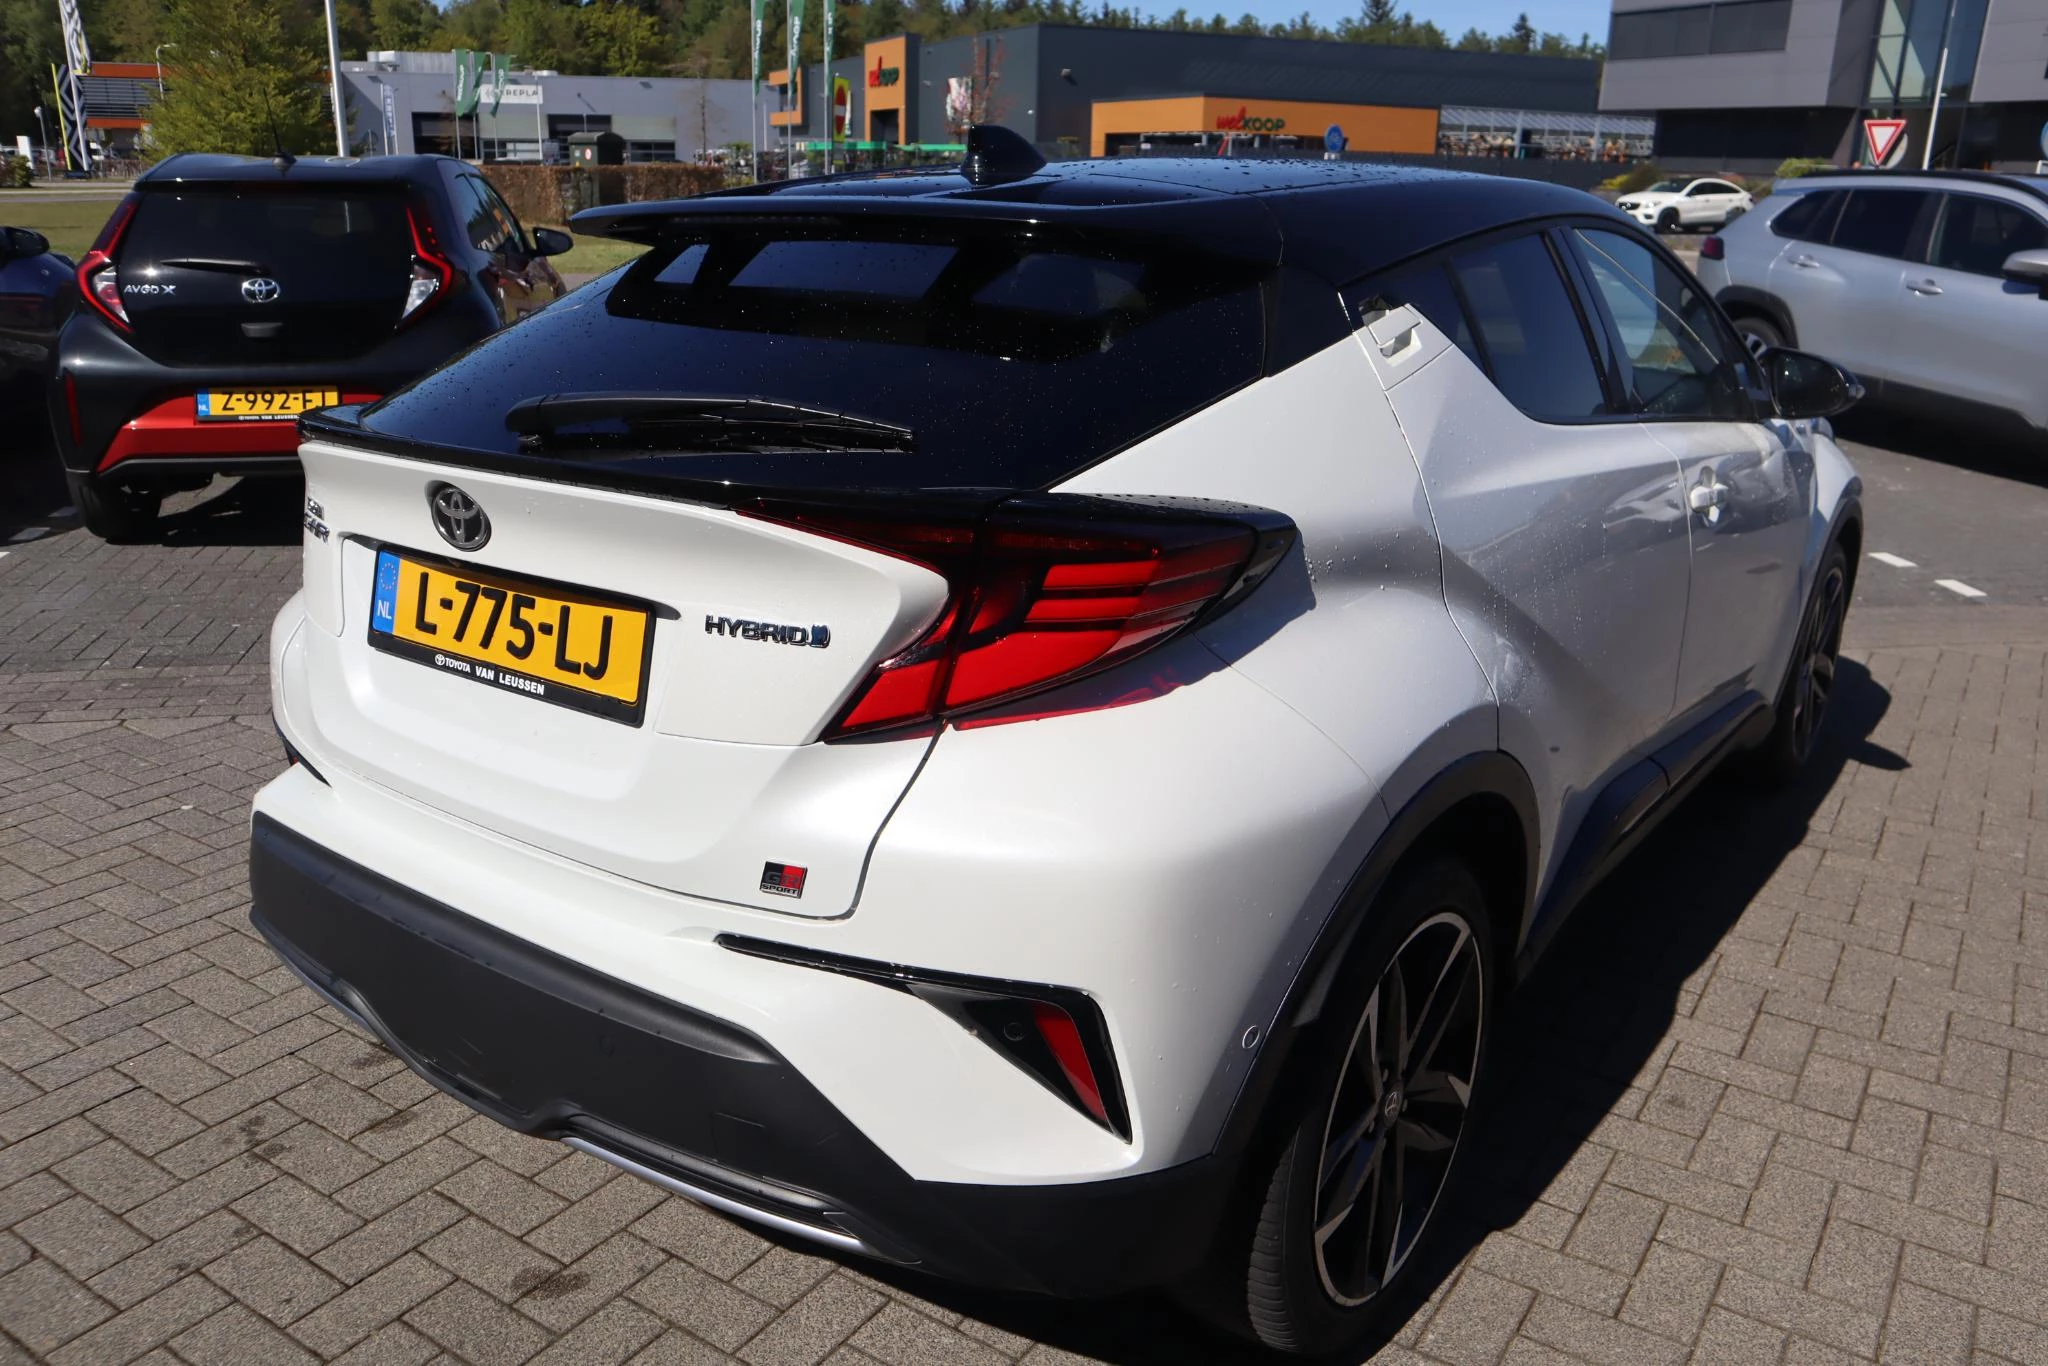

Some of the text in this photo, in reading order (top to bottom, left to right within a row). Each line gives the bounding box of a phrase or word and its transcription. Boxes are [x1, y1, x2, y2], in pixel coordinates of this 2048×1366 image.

[377, 600, 393, 620] NL
[415, 571, 613, 680] L-775-LJ
[705, 614, 808, 647] HYBRID
[445, 657, 545, 695] TOYOTA VAN LEUSSEN
[762, 884, 798, 895] SPORT
